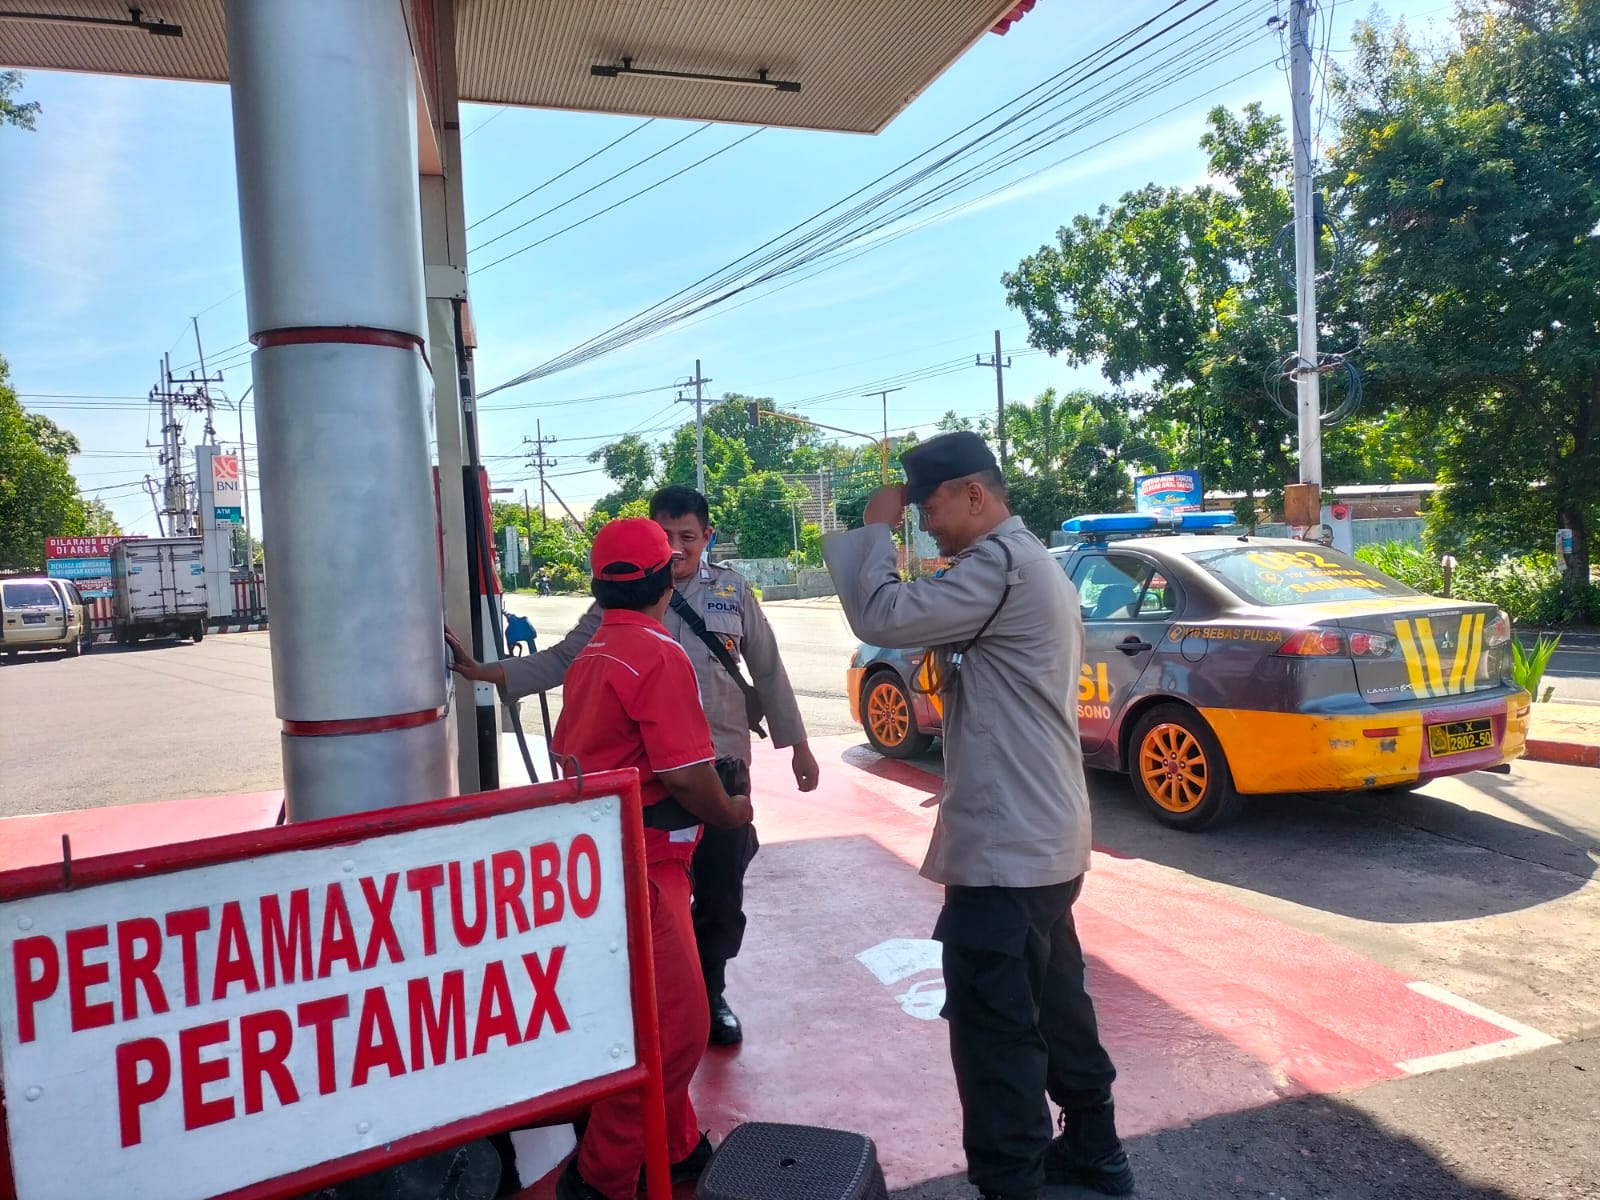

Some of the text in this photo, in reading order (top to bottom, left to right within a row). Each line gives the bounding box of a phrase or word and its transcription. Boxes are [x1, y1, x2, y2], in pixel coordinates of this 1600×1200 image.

[217, 481, 238, 491] BNI
[51, 538, 97, 546] DILARANG
[70, 545, 98, 554] AREA
[1242, 629, 1283, 642] PULSA
[1078, 662, 1110, 702] SI
[1077, 704, 1111, 720] SONO
[1466, 722, 1474, 732] X
[1451, 731, 1491, 751] 2802-50
[115, 945, 572, 1149] PERTAMAX
